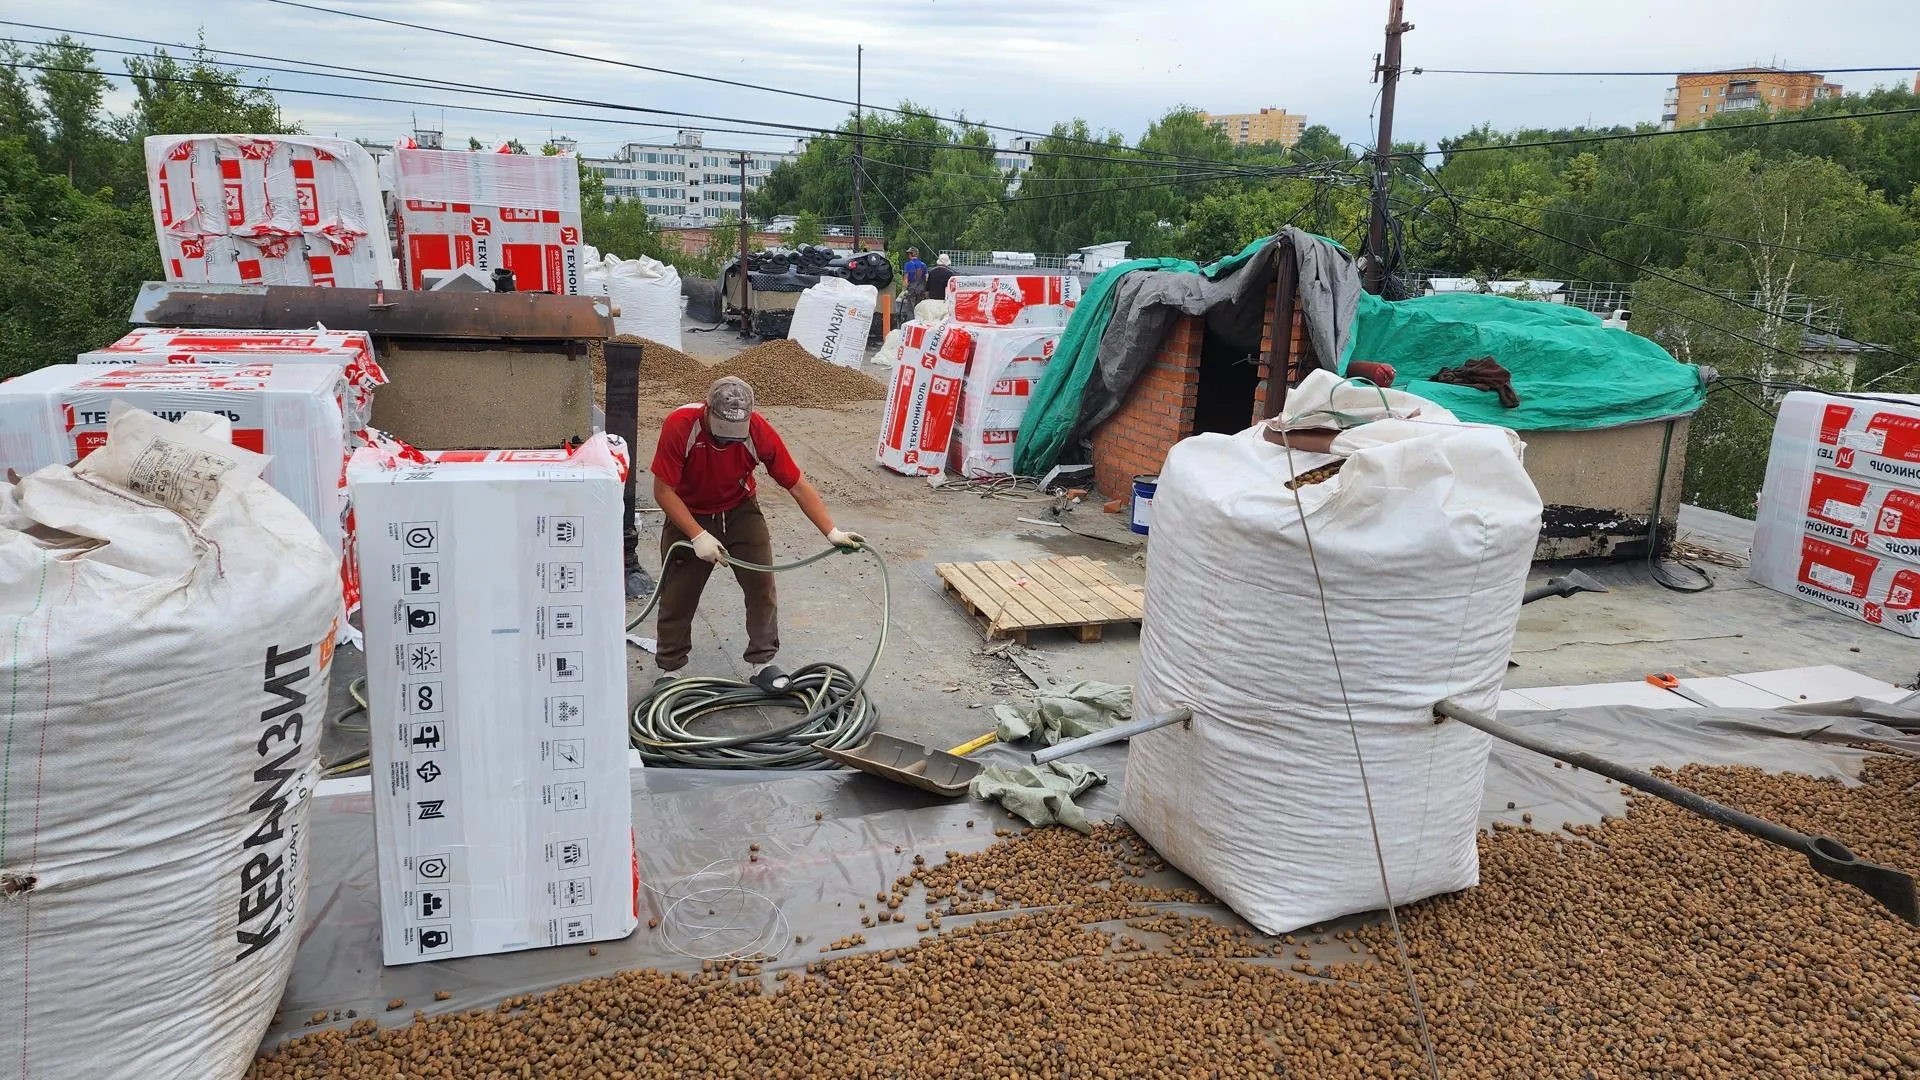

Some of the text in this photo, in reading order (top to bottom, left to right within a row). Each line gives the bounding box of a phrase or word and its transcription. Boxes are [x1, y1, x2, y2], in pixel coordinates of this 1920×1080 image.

[472, 217, 491, 236] TN
[561, 227, 578, 245] TN
[820, 303, 847, 362] КЕРАМЗИТ
[910, 382, 927, 449] ТЕХНОНИКОЛЬ
[86, 436, 106, 445] XPS
[1835, 447, 1855, 469] TN
[1851, 529, 1870, 549] TN
[236, 643, 313, 963] КЕРАМЗИТ
